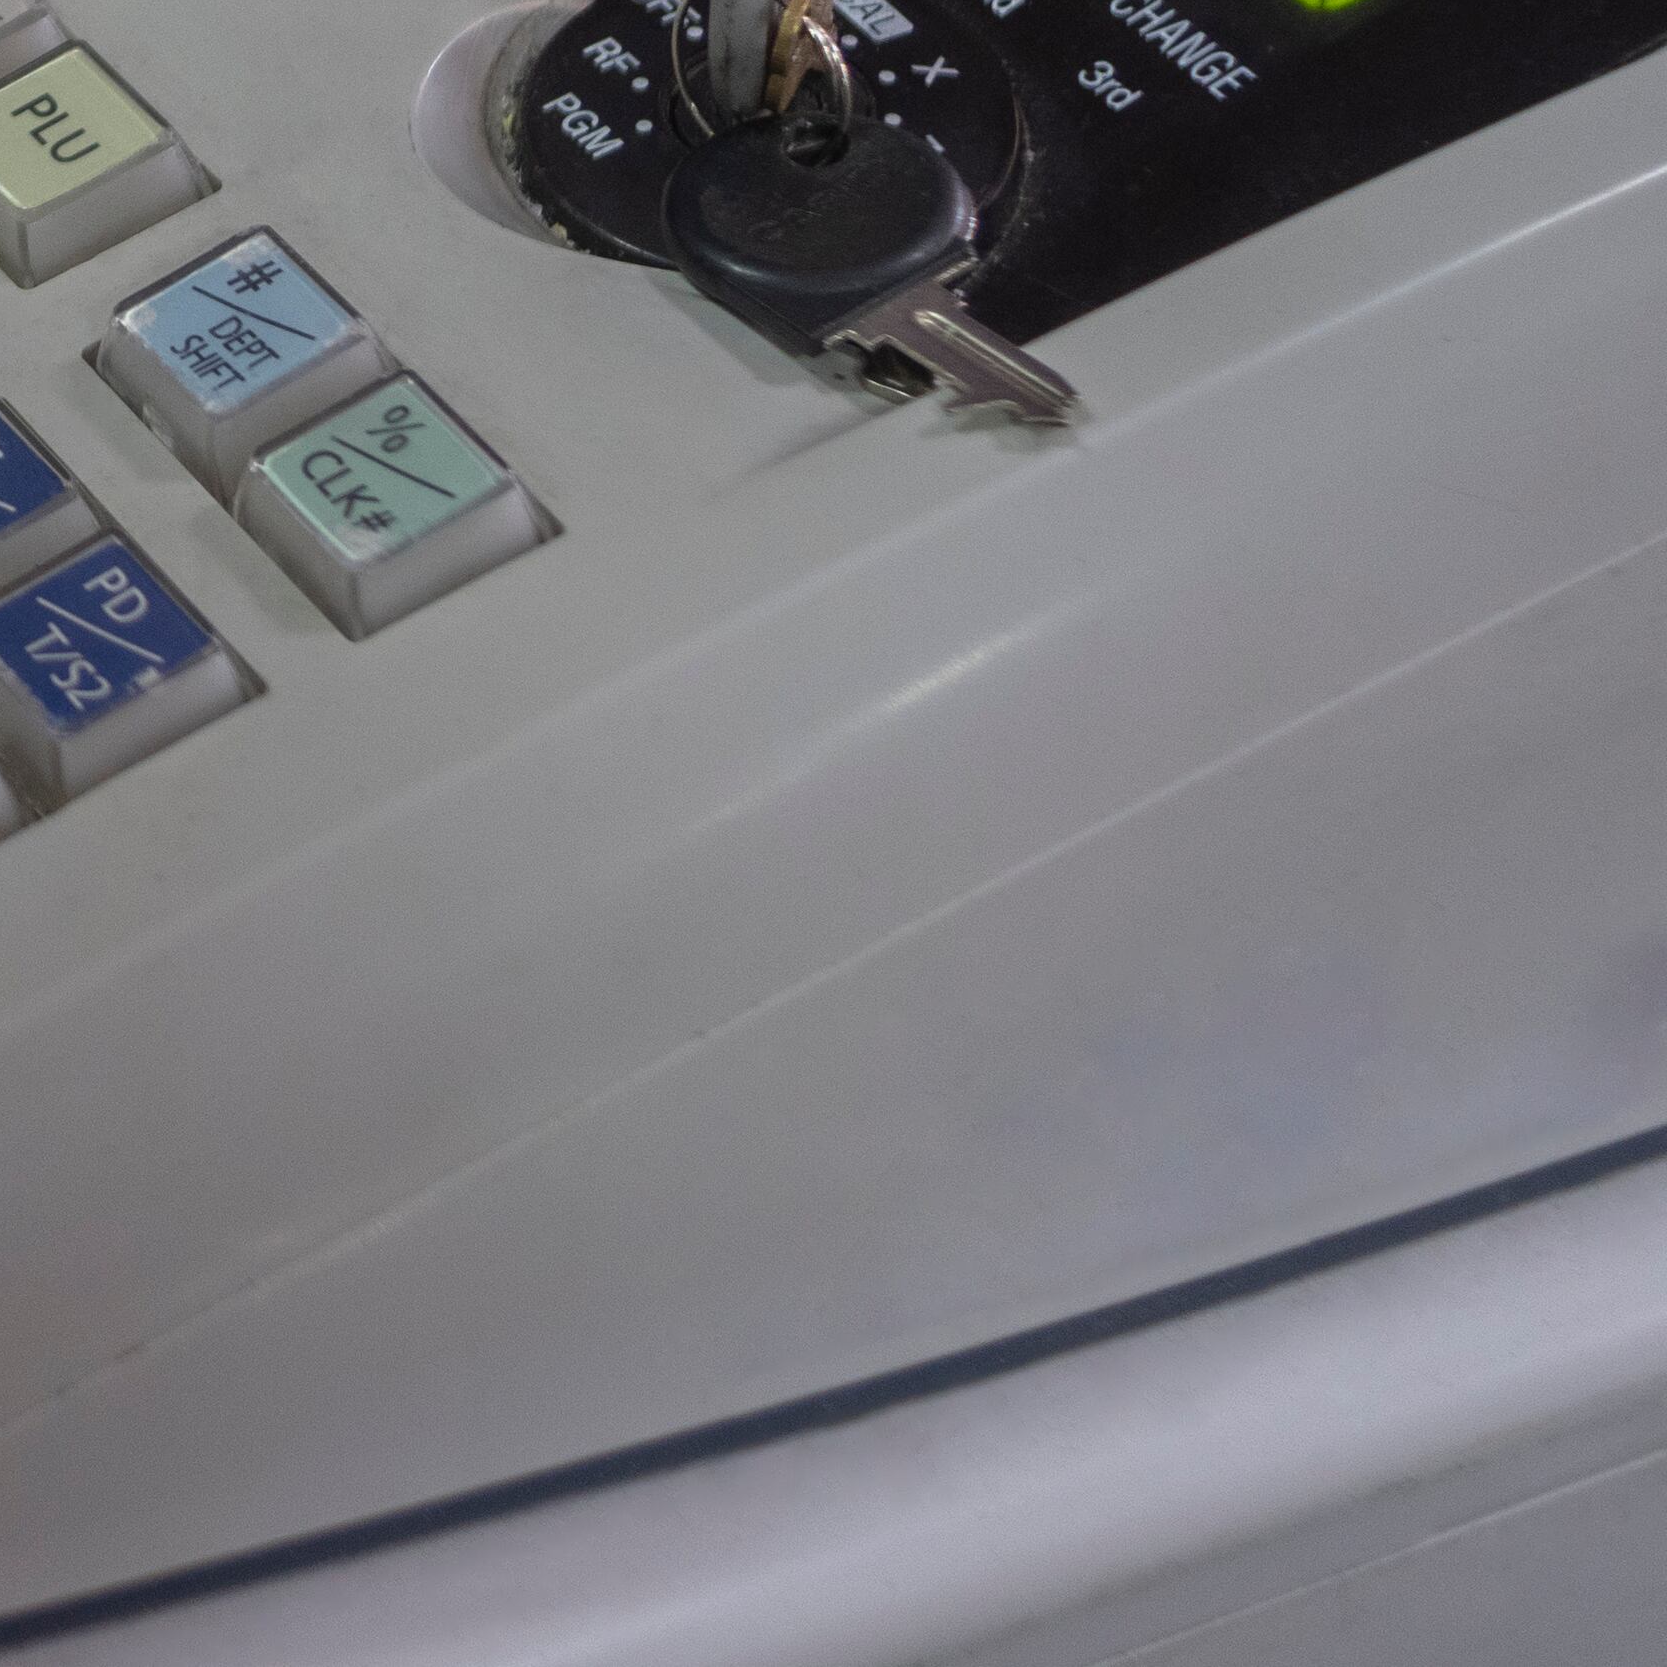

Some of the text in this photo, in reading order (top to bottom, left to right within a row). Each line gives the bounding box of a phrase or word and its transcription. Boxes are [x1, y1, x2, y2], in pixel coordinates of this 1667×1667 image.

[583, 36, 640, 77] RF
[1077, 59, 1144, 112] 3rd
[10, 91, 101, 164] PLU
[542, 92, 625, 161] PGM
[169, 333, 246, 390] SHIFT
[208, 315, 281, 369] DEPT
[300, 449, 397, 534] CLK#
[83, 565, 149, 624] PD
[23, 623, 112, 711] T/S2
